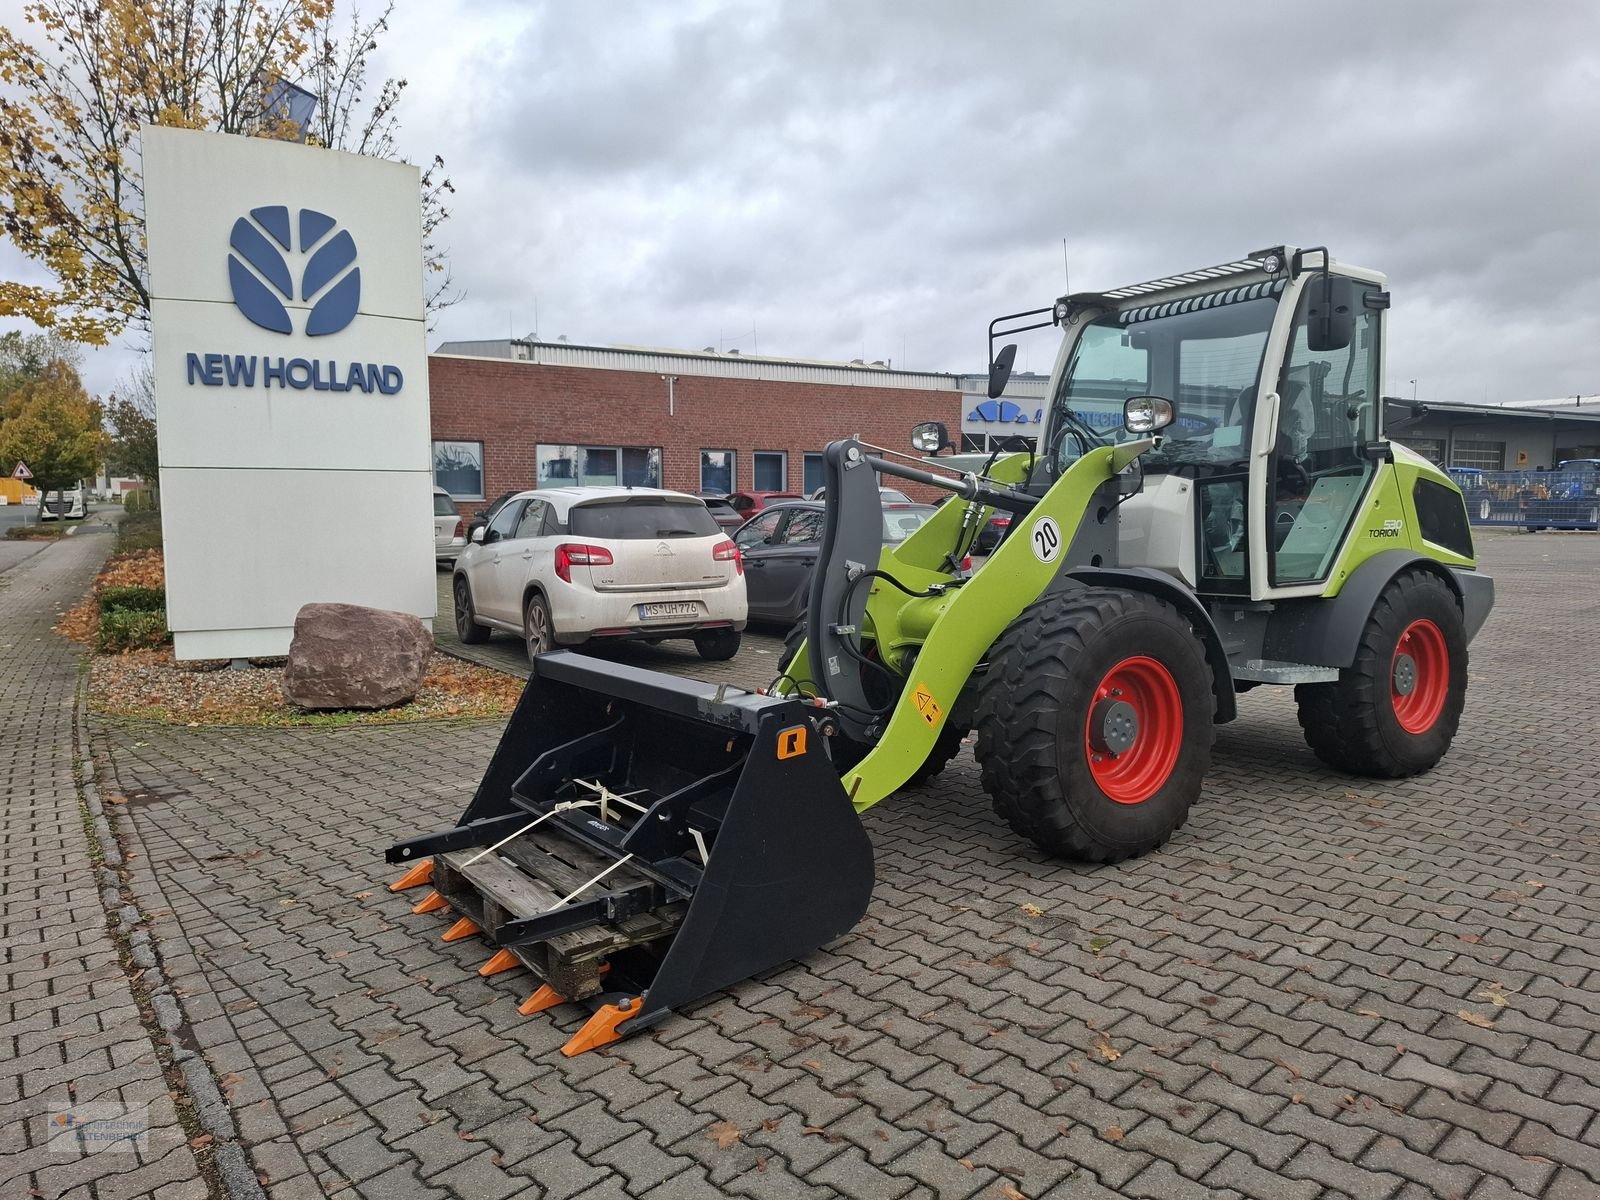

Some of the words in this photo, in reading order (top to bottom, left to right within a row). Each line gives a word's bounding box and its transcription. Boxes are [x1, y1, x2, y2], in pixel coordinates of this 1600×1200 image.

[186, 352, 257, 388] NEW
[263, 356, 404, 395] HOLLAND
[1383, 519, 1403, 529] 530
[1035, 522, 1058, 559] 20
[1368, 529, 1399, 538] TORION
[645, 605, 659, 616] MS
[664, 603, 678, 614] UH
[679, 602, 697, 613] 776
